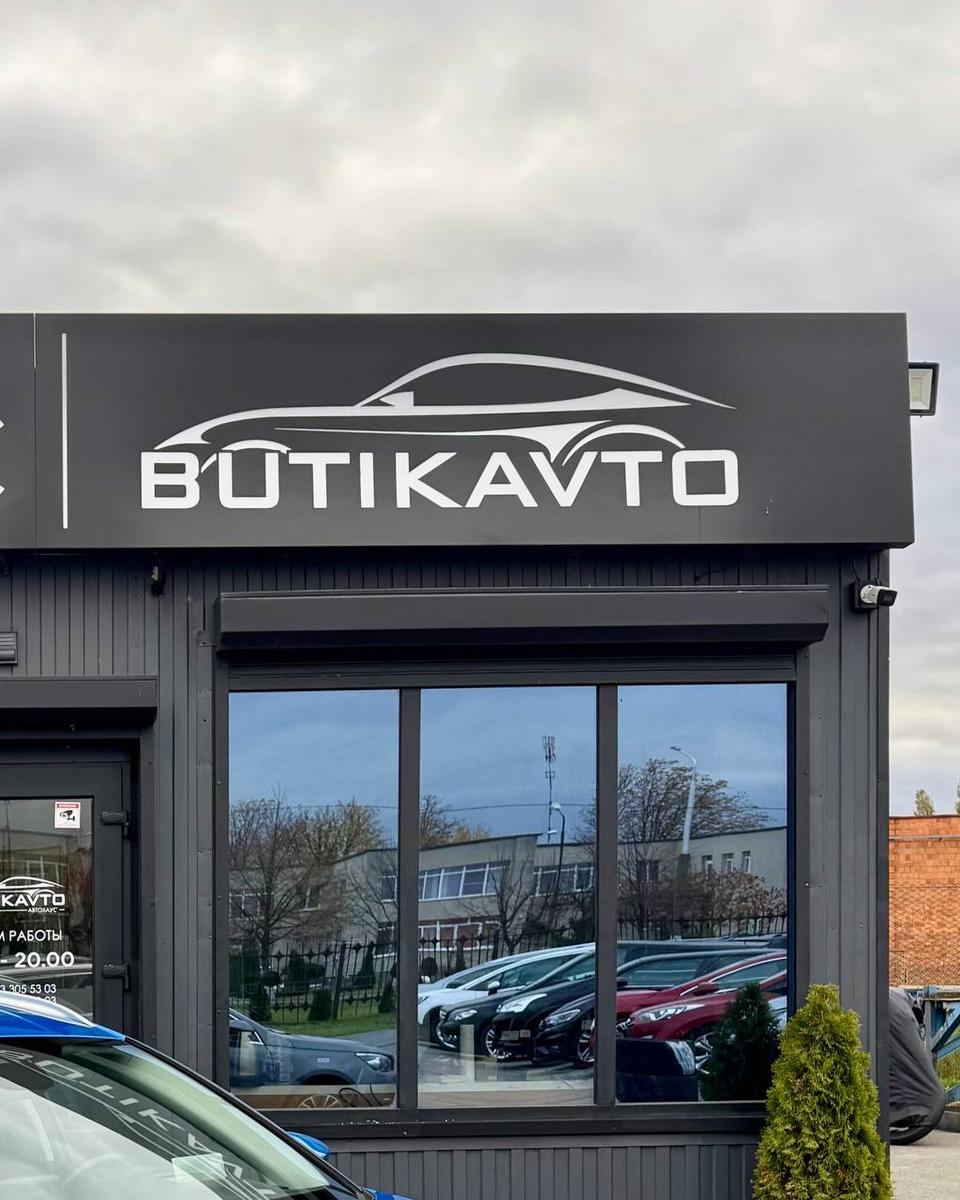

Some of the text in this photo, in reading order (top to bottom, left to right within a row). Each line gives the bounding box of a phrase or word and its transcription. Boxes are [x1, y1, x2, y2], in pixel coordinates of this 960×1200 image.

[140, 448, 739, 510] BUTIKAVTO
[9, 929, 62, 941] РАБОТЫ
[14, 951, 75, 968] 20.00
[8, 984, 27, 994] 305
[30, 984, 42, 994] 53
[44, 983, 57, 994] 03
